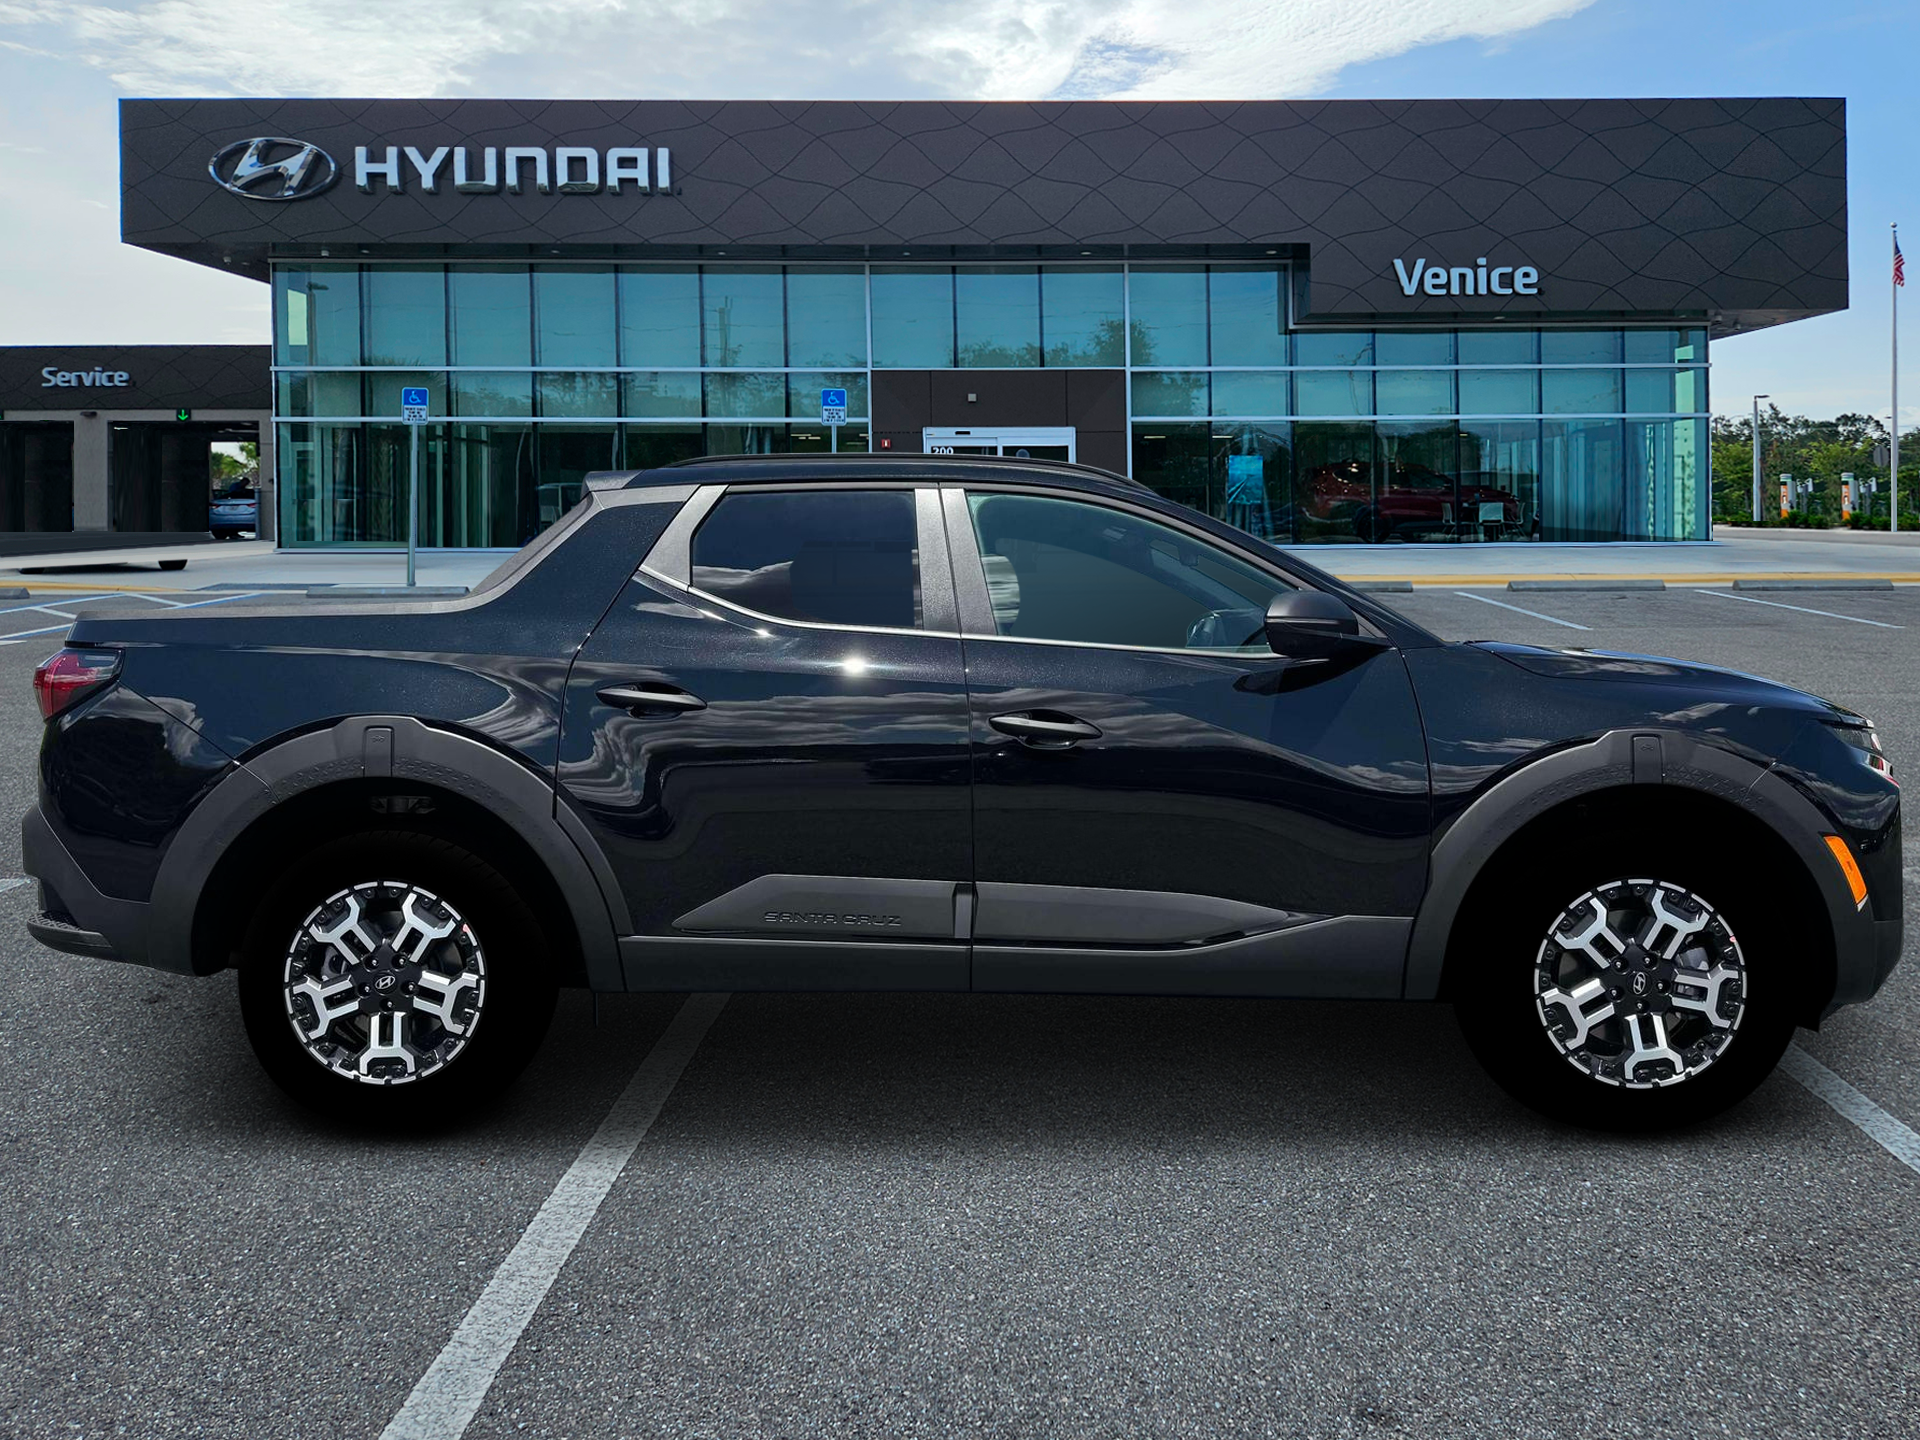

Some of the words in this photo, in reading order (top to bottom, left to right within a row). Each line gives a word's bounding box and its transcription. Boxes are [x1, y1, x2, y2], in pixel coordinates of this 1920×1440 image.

[354, 145, 671, 194] HYUNDAI
[1392, 256, 1539, 296] Venice
[41, 366, 130, 387] Service
[763, 911, 838, 924] SANTA
[842, 914, 901, 926] CRUZ
